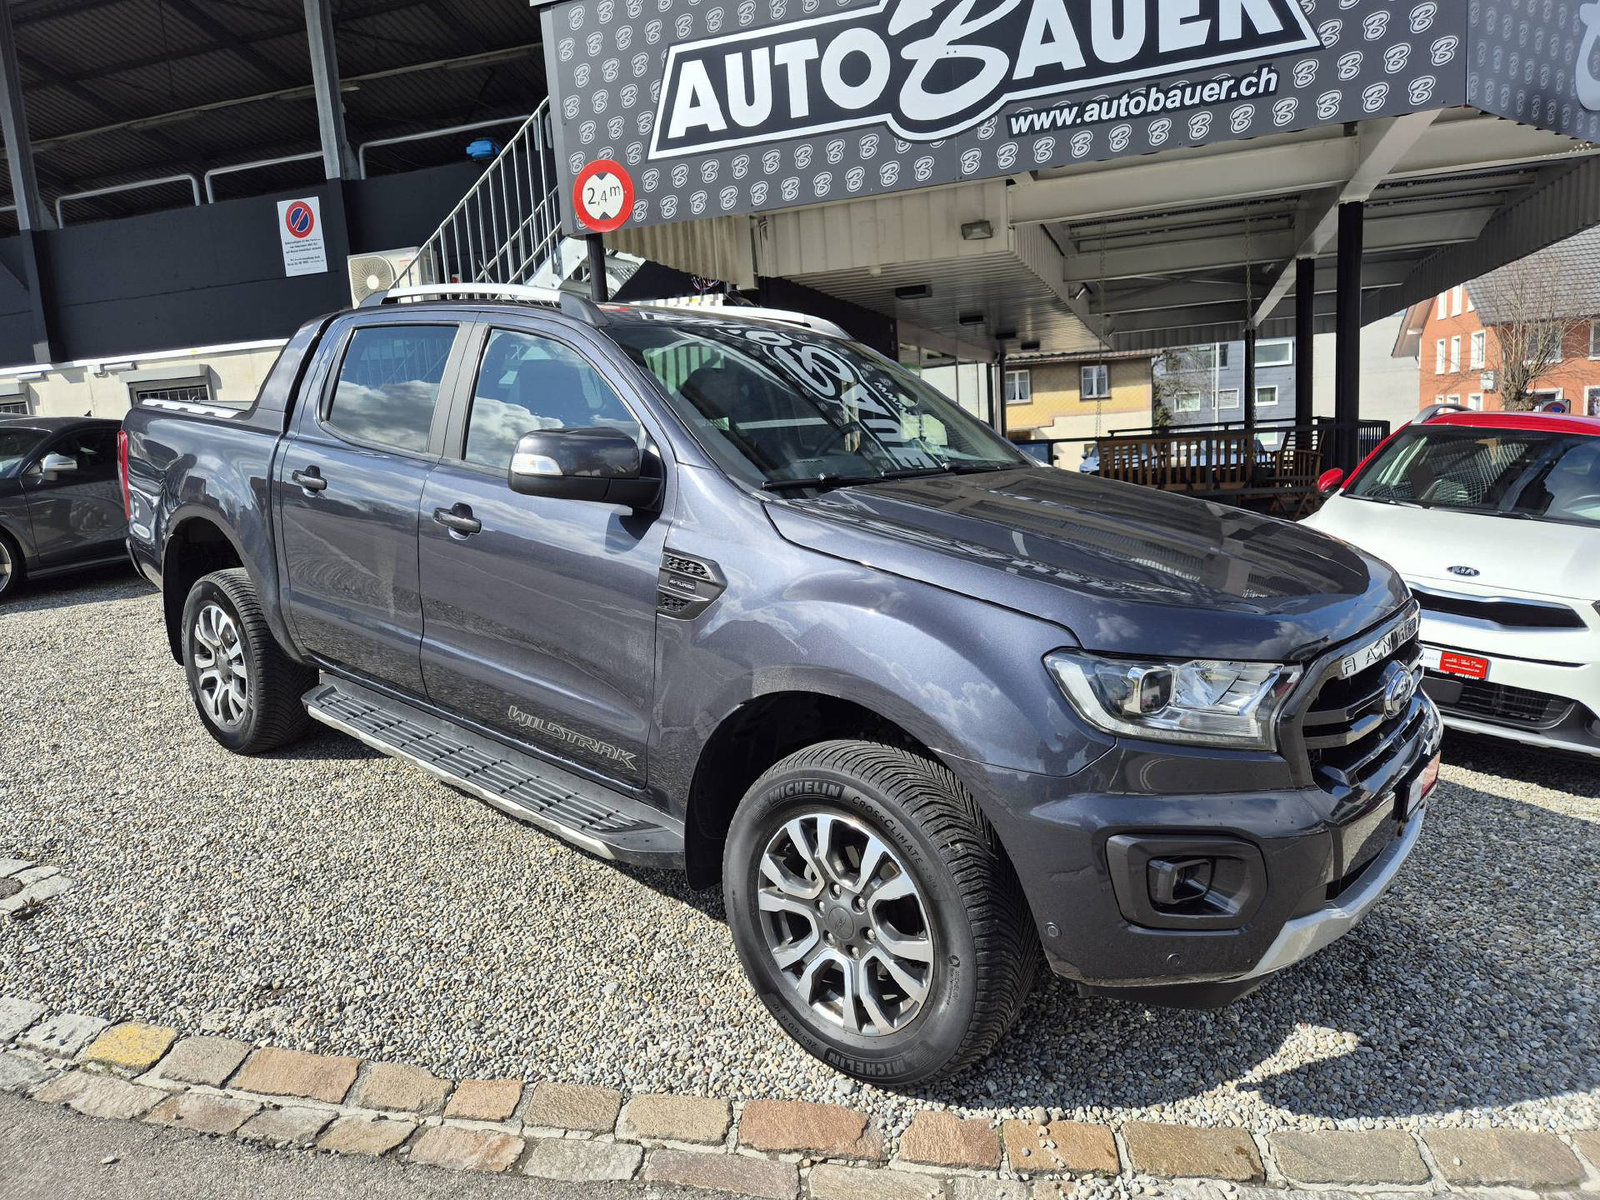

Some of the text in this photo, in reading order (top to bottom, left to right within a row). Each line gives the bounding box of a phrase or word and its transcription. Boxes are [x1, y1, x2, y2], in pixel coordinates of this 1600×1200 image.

[667, 27, 891, 139] AUTO
[1011, 67, 1277, 135] www.autobauer.ch
[508, 705, 637, 771] WILDTRAK
[768, 781, 841, 803] MICHELIN
[852, 796, 923, 864] CROSSCLIMATE
[827, 1051, 906, 1076] MICHELIN
